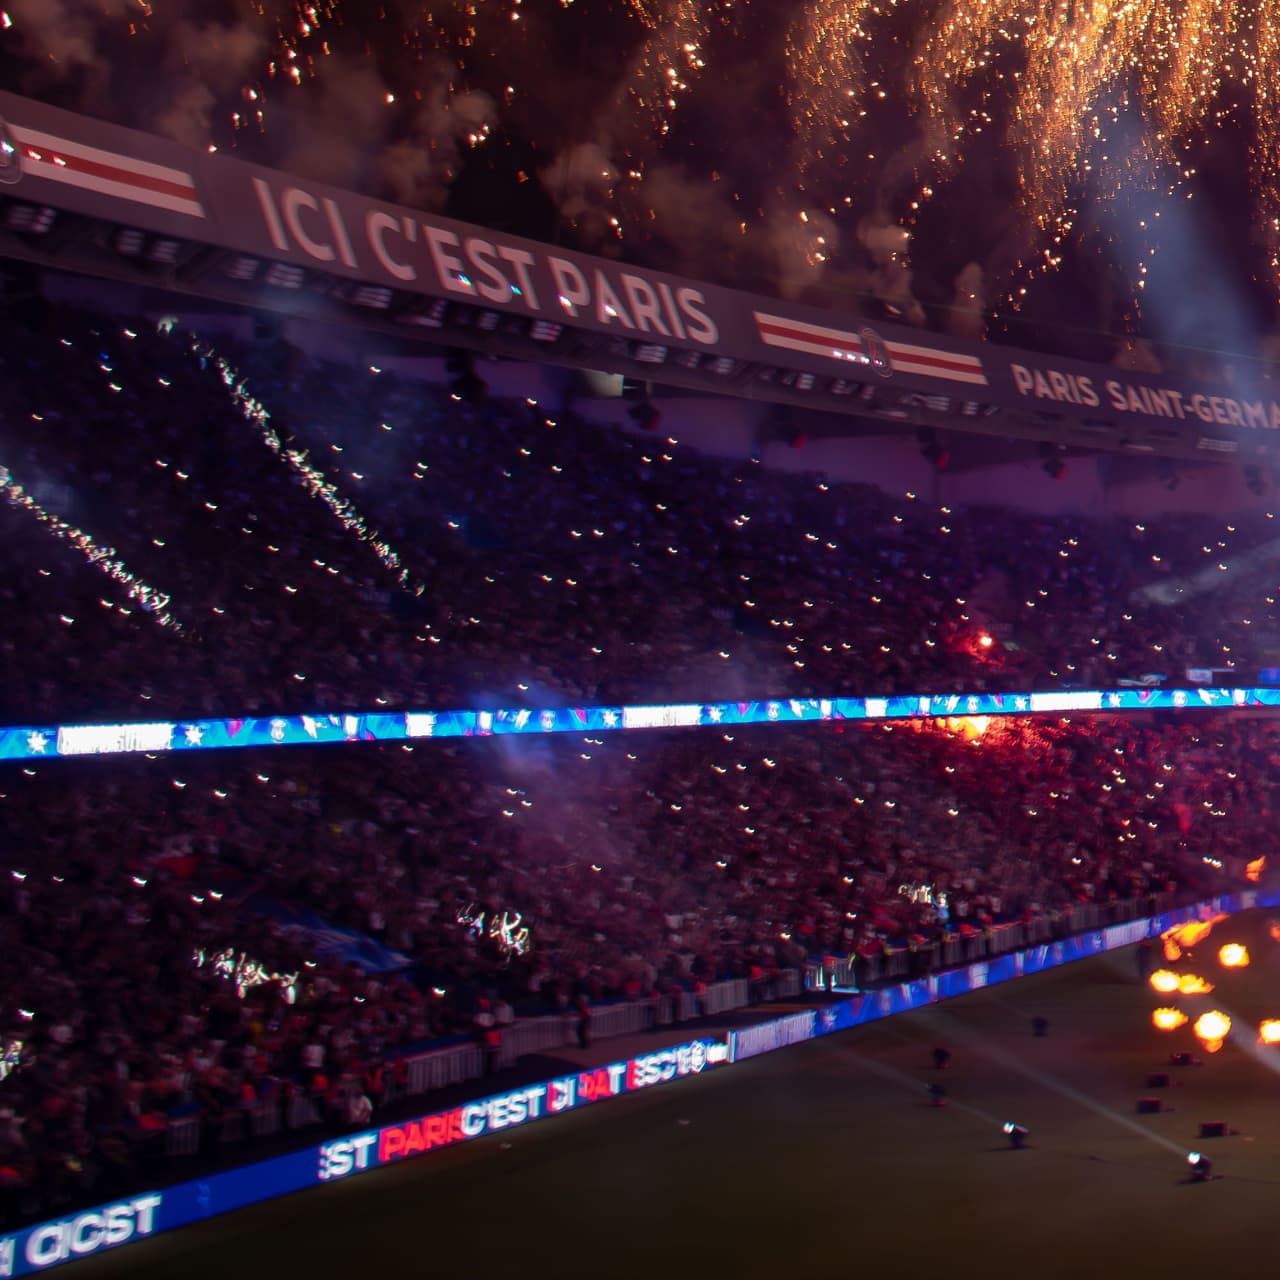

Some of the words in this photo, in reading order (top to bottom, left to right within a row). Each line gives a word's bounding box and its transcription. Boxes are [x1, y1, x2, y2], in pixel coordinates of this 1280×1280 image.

[252, 176, 359, 268] ICI
[366, 211, 542, 311] C'EST
[549, 256, 720, 345] PARIS
[1009, 363, 1100, 408] PARIS
